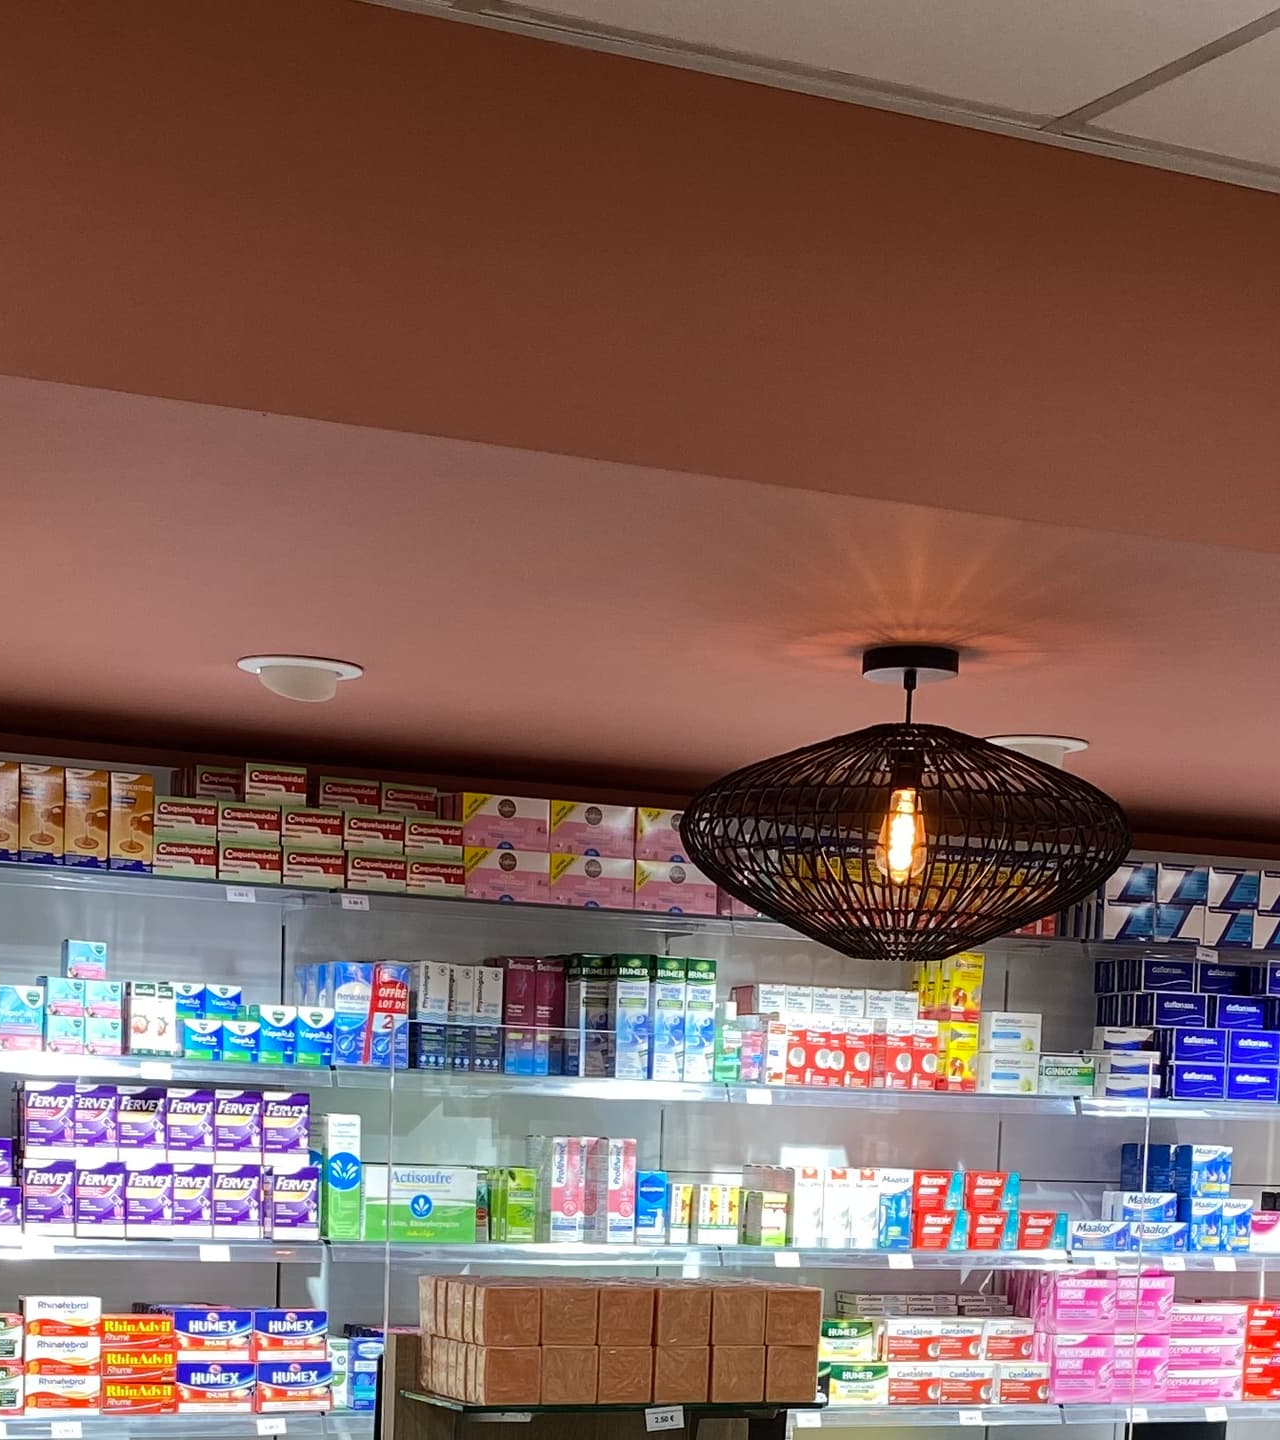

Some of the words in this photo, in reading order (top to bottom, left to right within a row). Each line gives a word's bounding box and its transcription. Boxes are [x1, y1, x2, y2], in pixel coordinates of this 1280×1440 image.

[379, 988, 407, 998] OFFRE
[378, 1000, 395, 1009] LOT
[397, 1001, 407, 1009] DE
[120, 1097, 164, 1111] FERVEX
[170, 1099, 213, 1115] FERVEX
[218, 1101, 260, 1115] FERVEX
[276, 1176, 317, 1191] FERVEX
[1076, 1222, 1110, 1233] Maalox
[104, 1320, 171, 1332] RhinAdvil
[188, 1320, 237, 1333] HUMEX
[269, 1320, 313, 1332] HUMEX
[896, 1328, 933, 1336] Cantalène
[106, 1353, 173, 1365] RhinAdvil
[191, 1371, 239, 1385] HUMEX
[272, 1371, 318, 1383] HUMEX
[655, 1415, 669, 1424] 2.50
